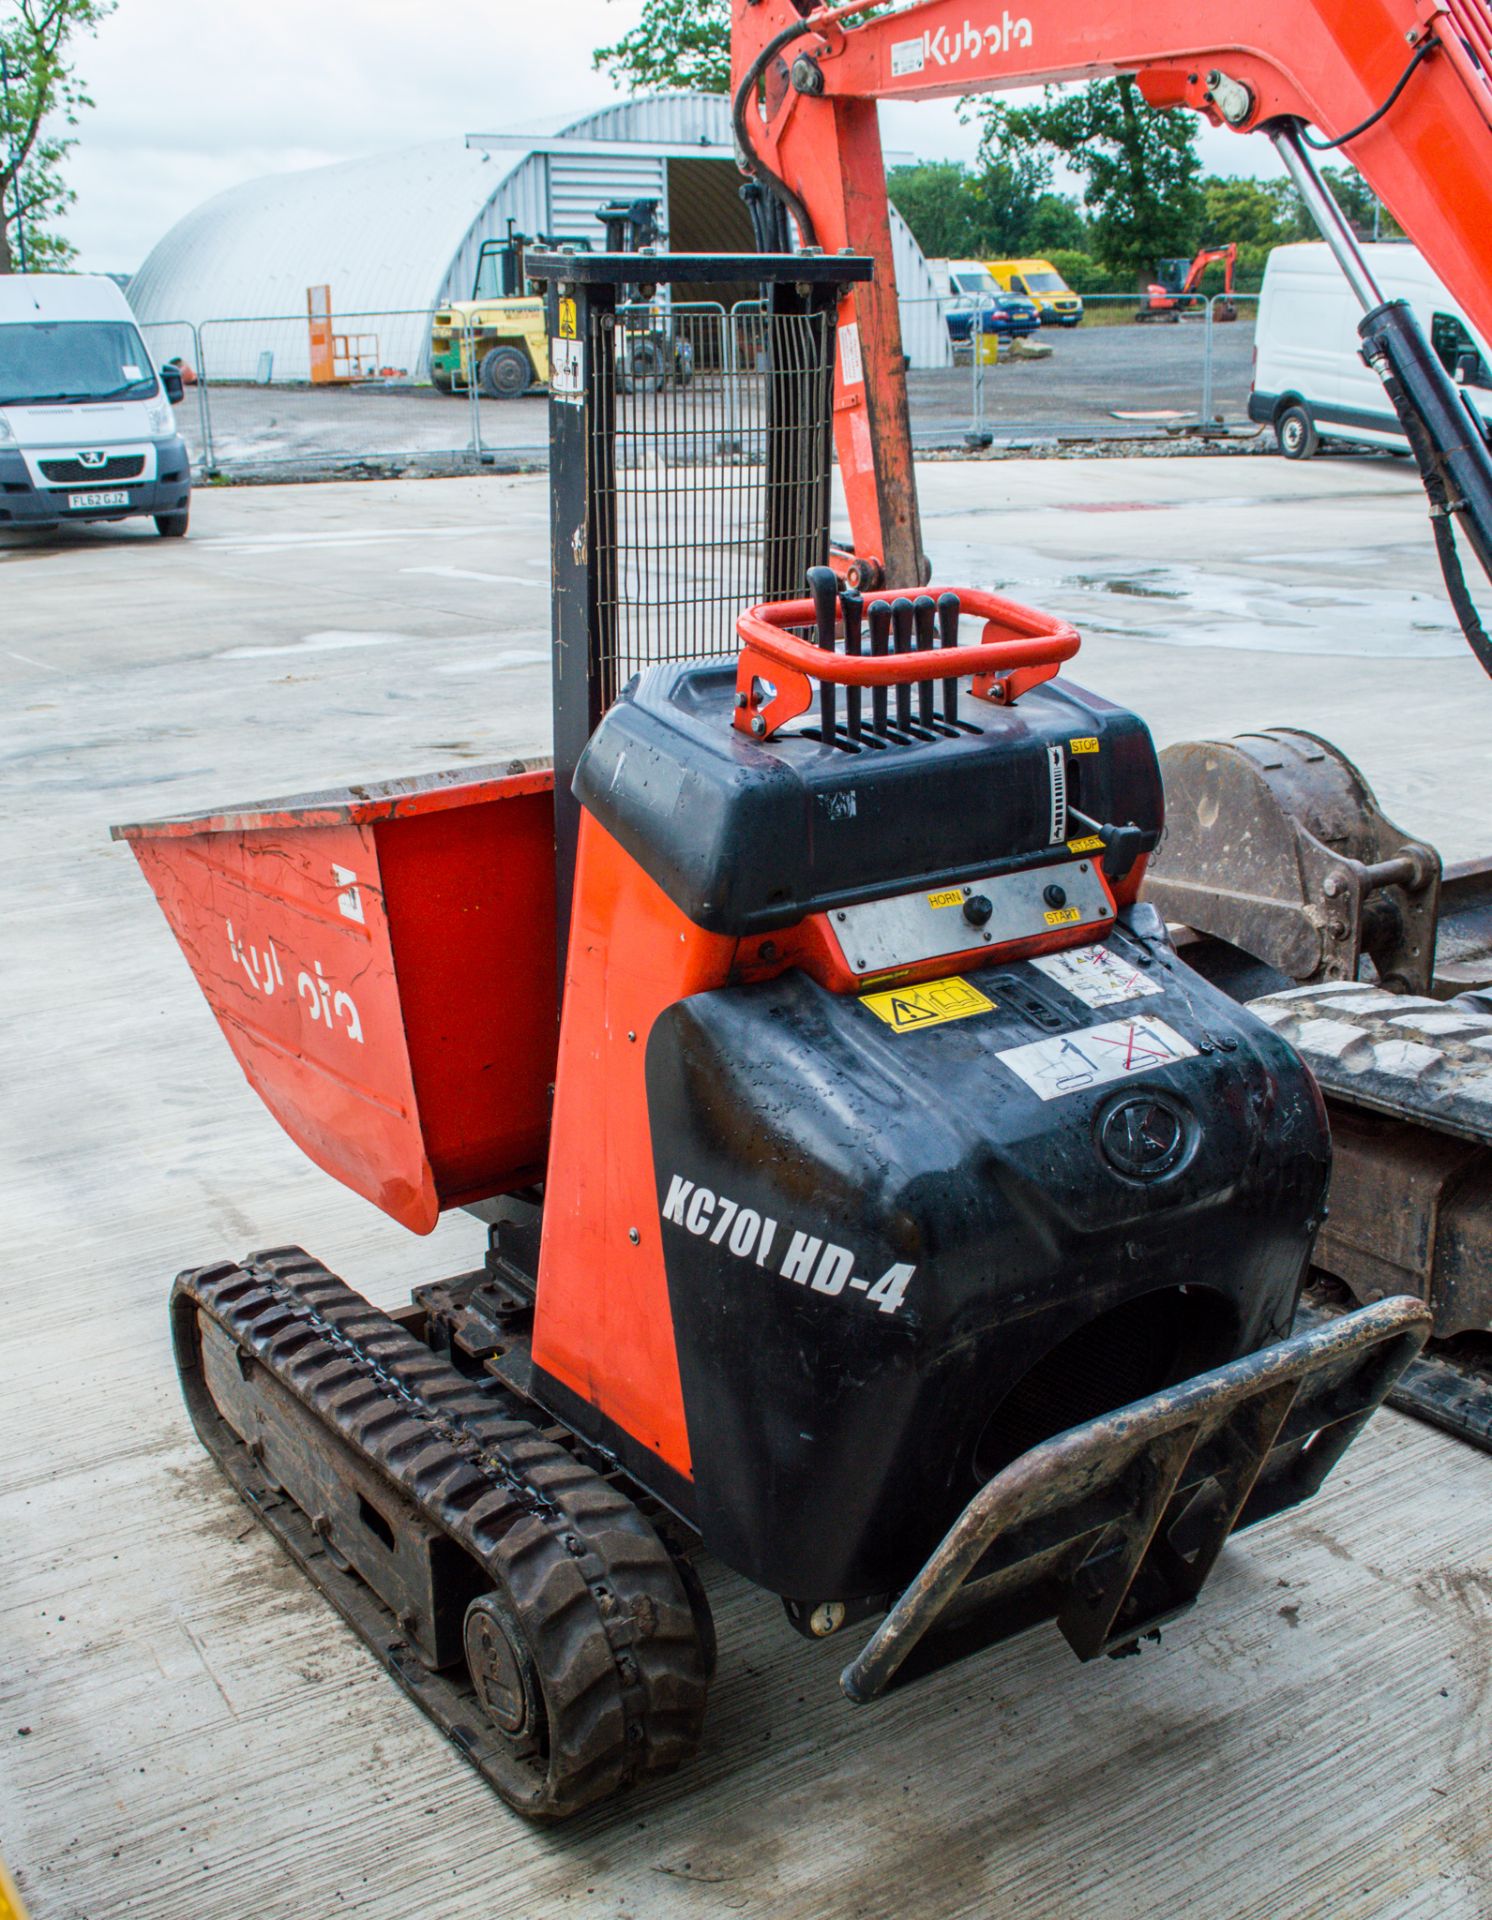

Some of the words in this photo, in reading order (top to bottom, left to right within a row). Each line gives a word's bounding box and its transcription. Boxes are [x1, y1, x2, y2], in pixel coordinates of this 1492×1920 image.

[924, 10, 1032, 66] Kubota
[73, 494, 101, 506] FL62
[1071, 740, 1097, 752] STOP
[928, 892, 962, 907] HORN
[1046, 907, 1079, 924] START
[662, 1174, 778, 1267] KC701
[779, 1230, 917, 1314] HD-4
